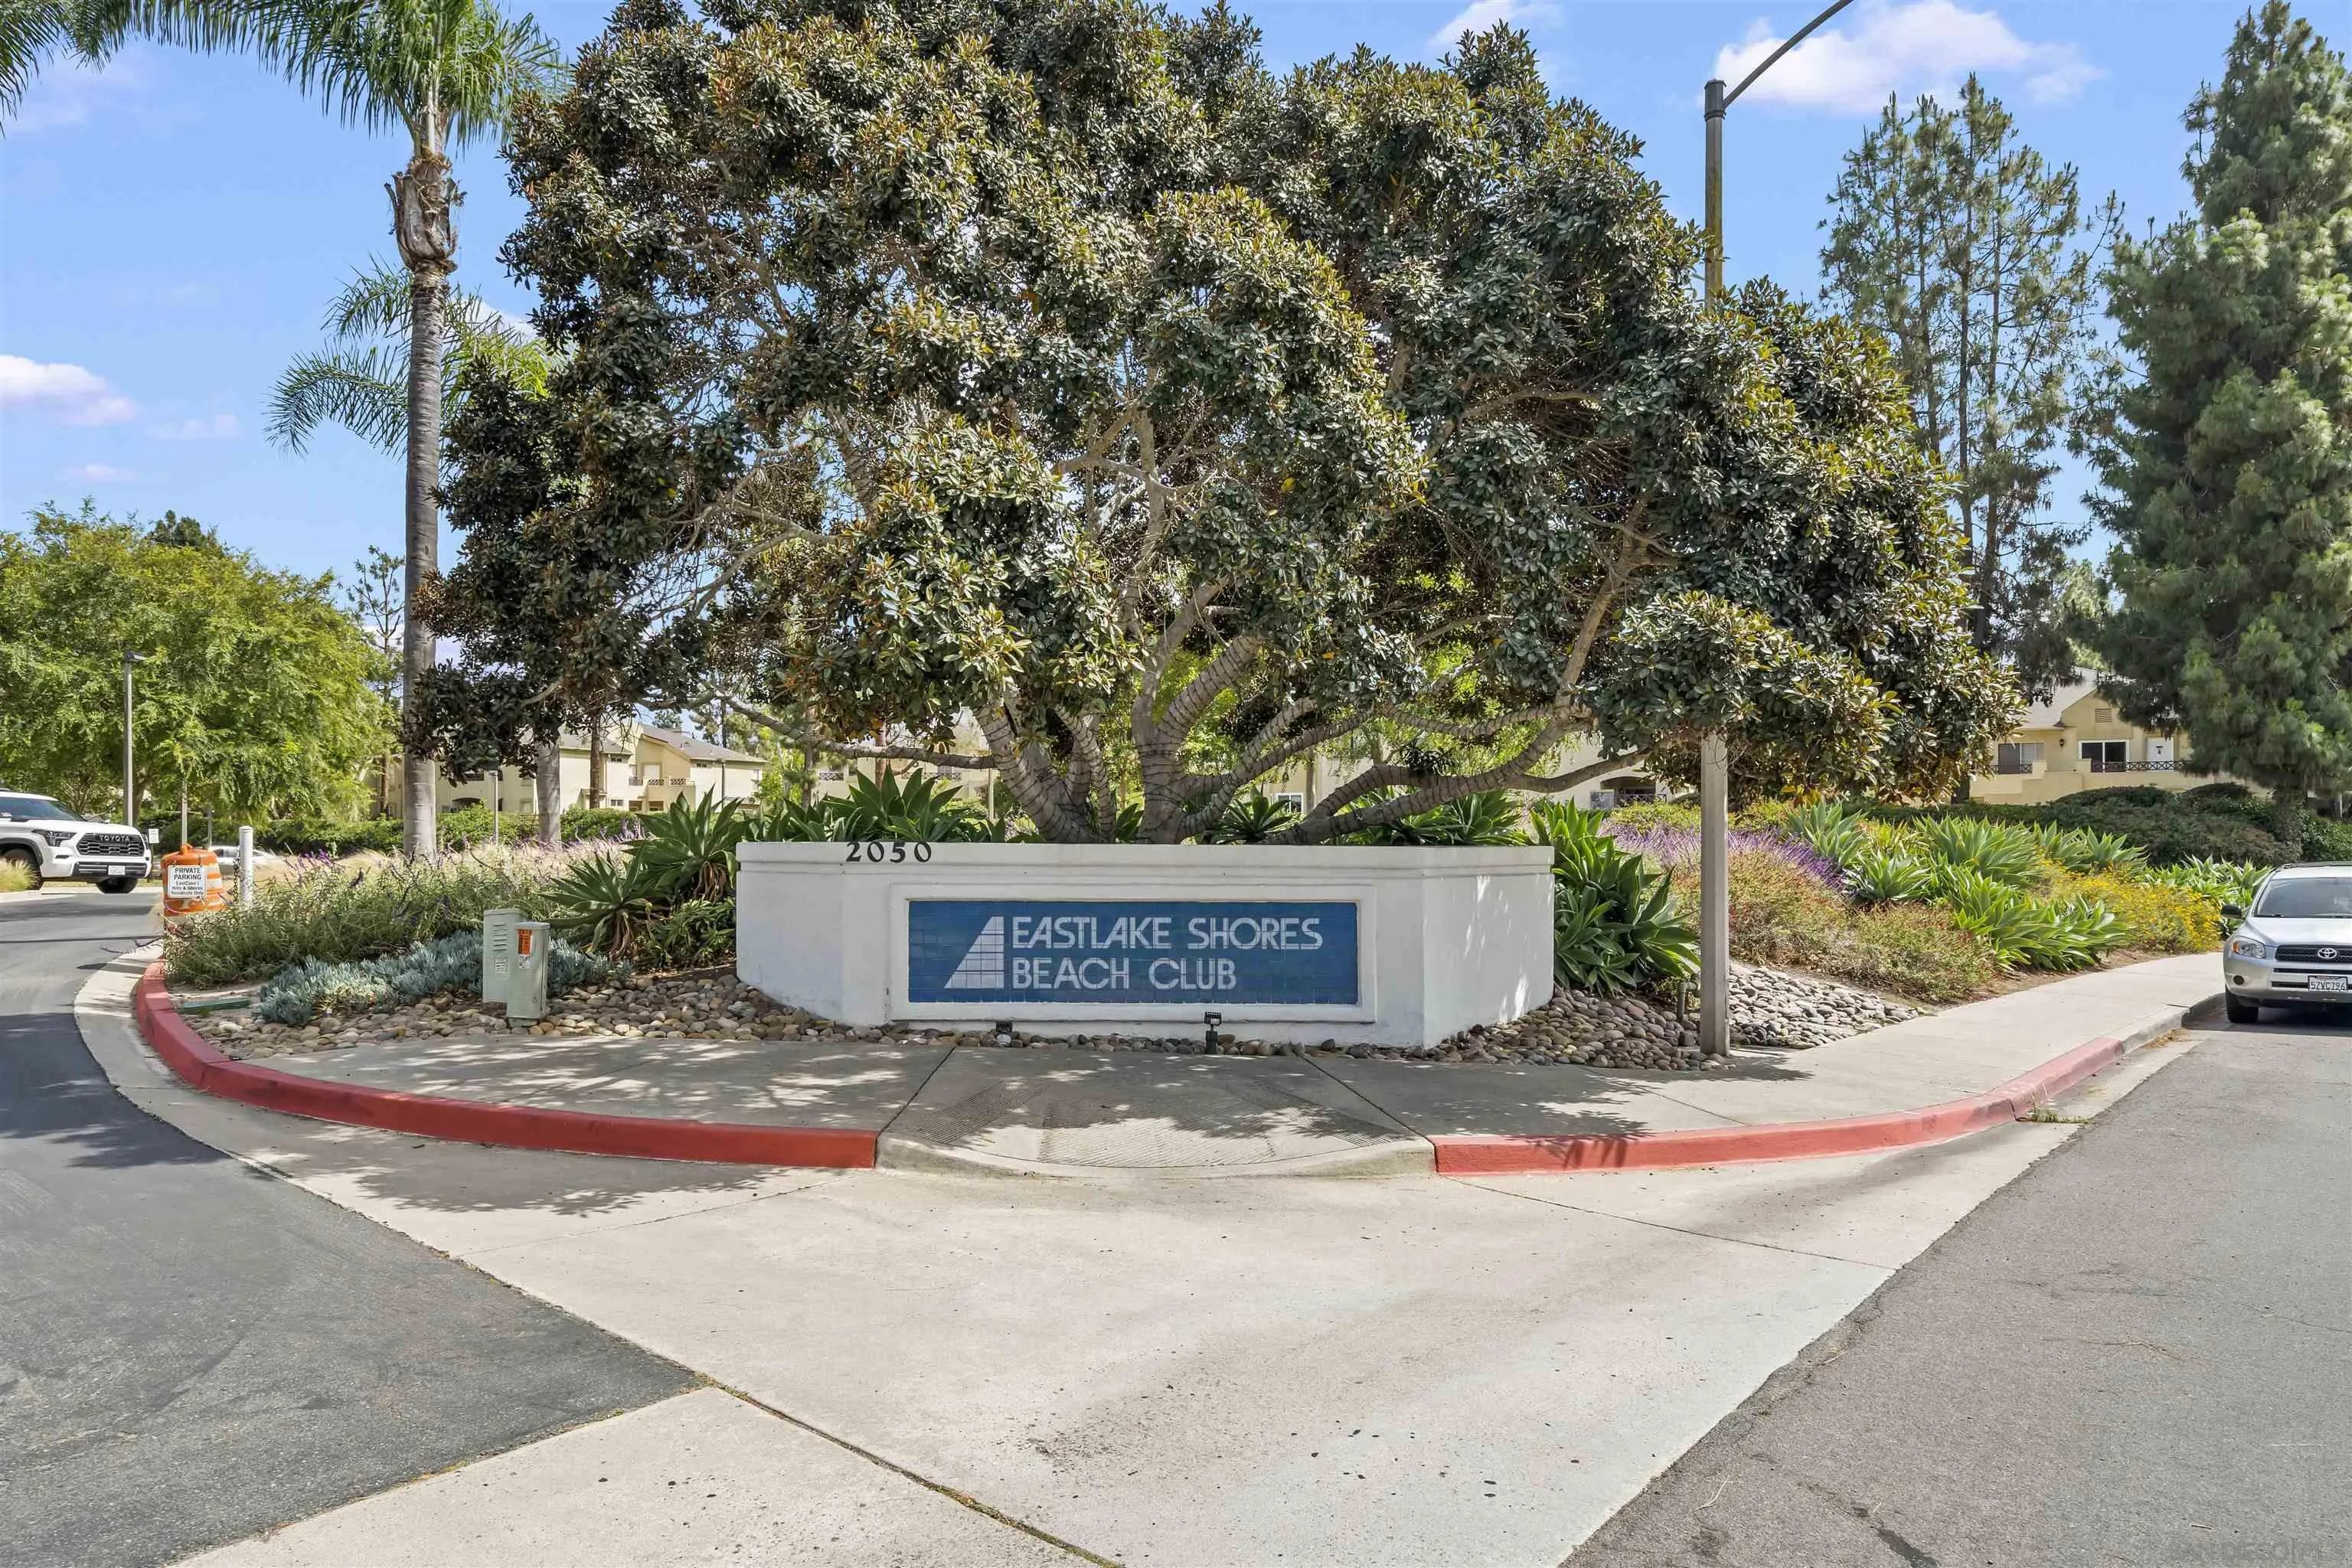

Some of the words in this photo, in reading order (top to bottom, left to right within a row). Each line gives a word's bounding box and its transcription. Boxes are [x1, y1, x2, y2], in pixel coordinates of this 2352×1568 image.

[846, 841, 932, 863] 2050
[1012, 916, 1172, 950] EASTLAKE
[1187, 917, 1323, 950] SHORES
[1012, 958, 1130, 990] BEACH
[1148, 958, 1237, 990] CLUB
